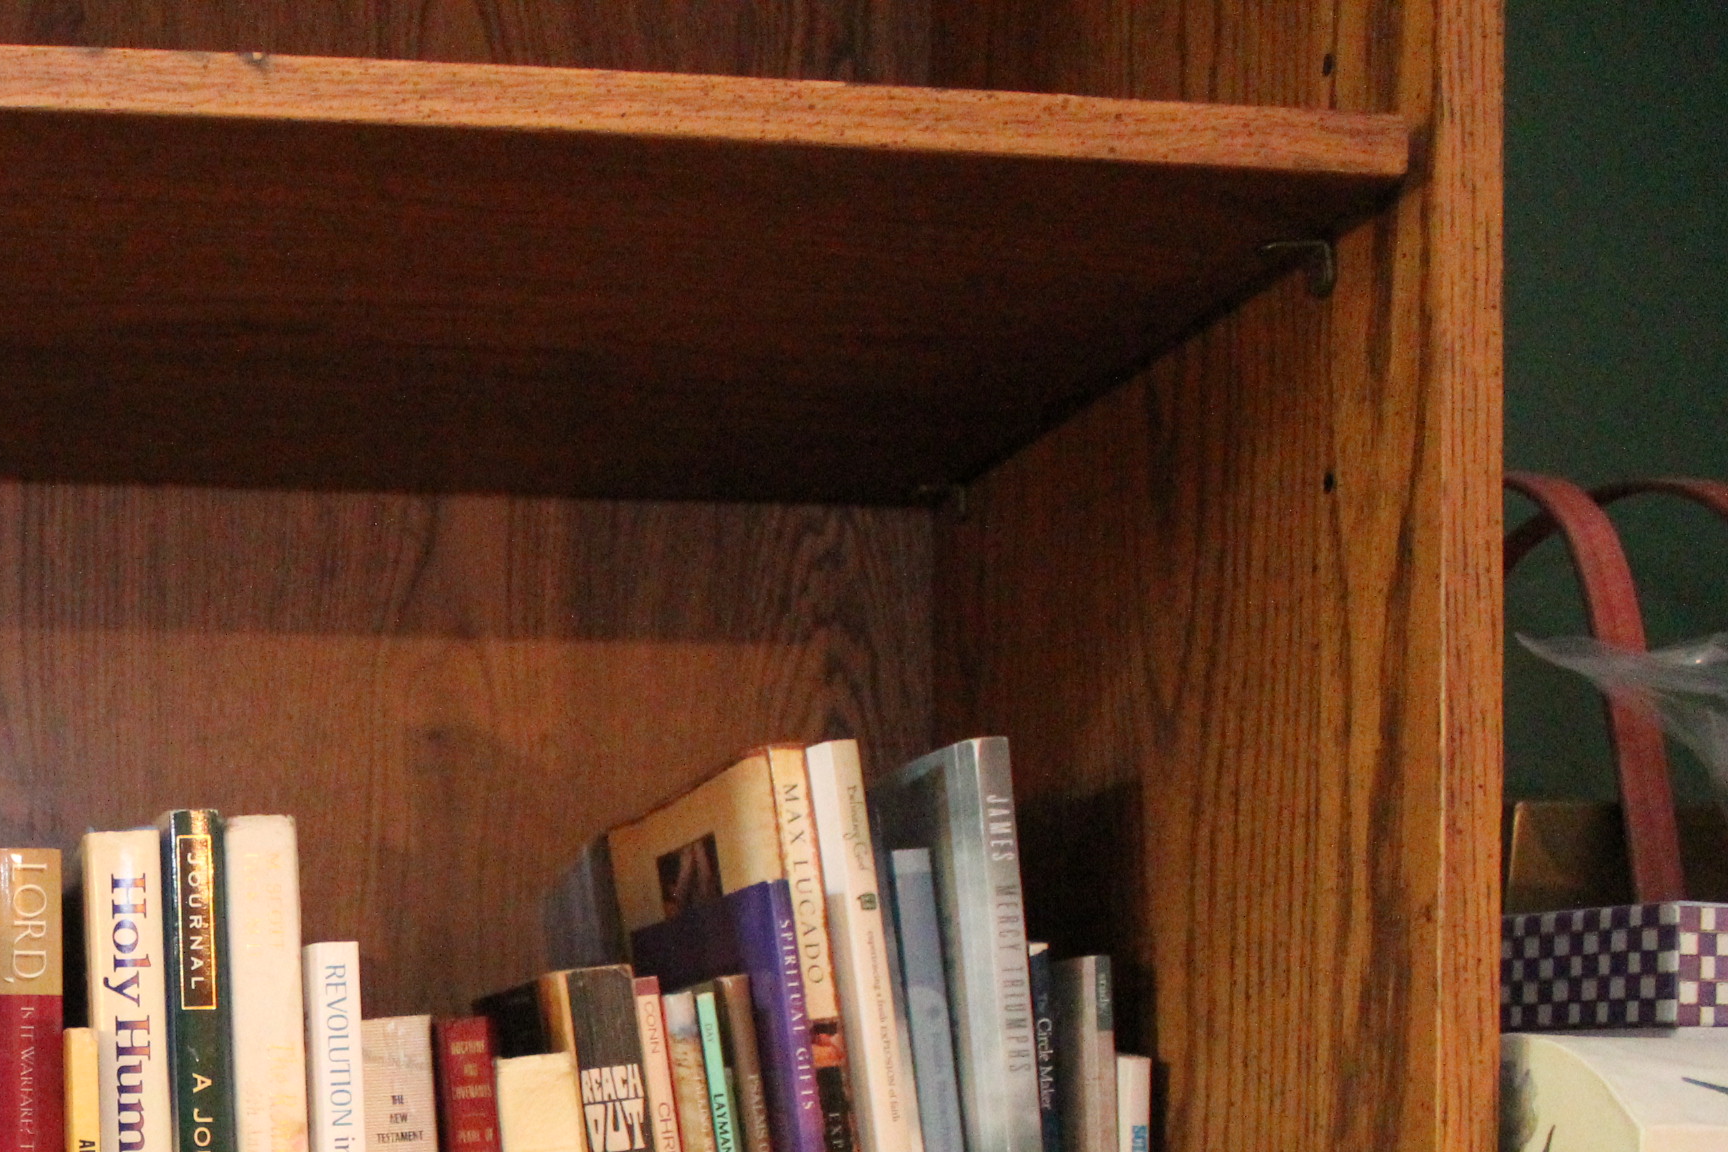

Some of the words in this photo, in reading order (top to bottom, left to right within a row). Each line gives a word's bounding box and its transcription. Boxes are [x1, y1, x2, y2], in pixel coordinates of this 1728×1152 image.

[783, 783, 807, 844] MAX
[986, 793, 1015, 862] JAMES
[3, 863, 48, 983] LORD,
[104, 873, 152, 1007] Holy
[187, 851, 205, 990] JOURNAL
[793, 858, 824, 985] LUCADO
[995, 884, 1023, 951] MERCY
[325, 963, 353, 1126] REVOLUTION
[643, 1001, 660, 1055] CONN
[780, 918, 806, 1032] SPIRITUAL
[795, 1046, 816, 1111] GIFTS
[1002, 965, 1031, 1074] TRIUMPHS
[1037, 1017, 1053, 1062] Circle
[192, 1072, 212, 1094] A
[581, 1063, 645, 1104] REACH
[1040, 1065, 1056, 1110] Maker
[377, 1130, 424, 1144] TESTAMENT
[390, 1113, 408, 1123] NEW
